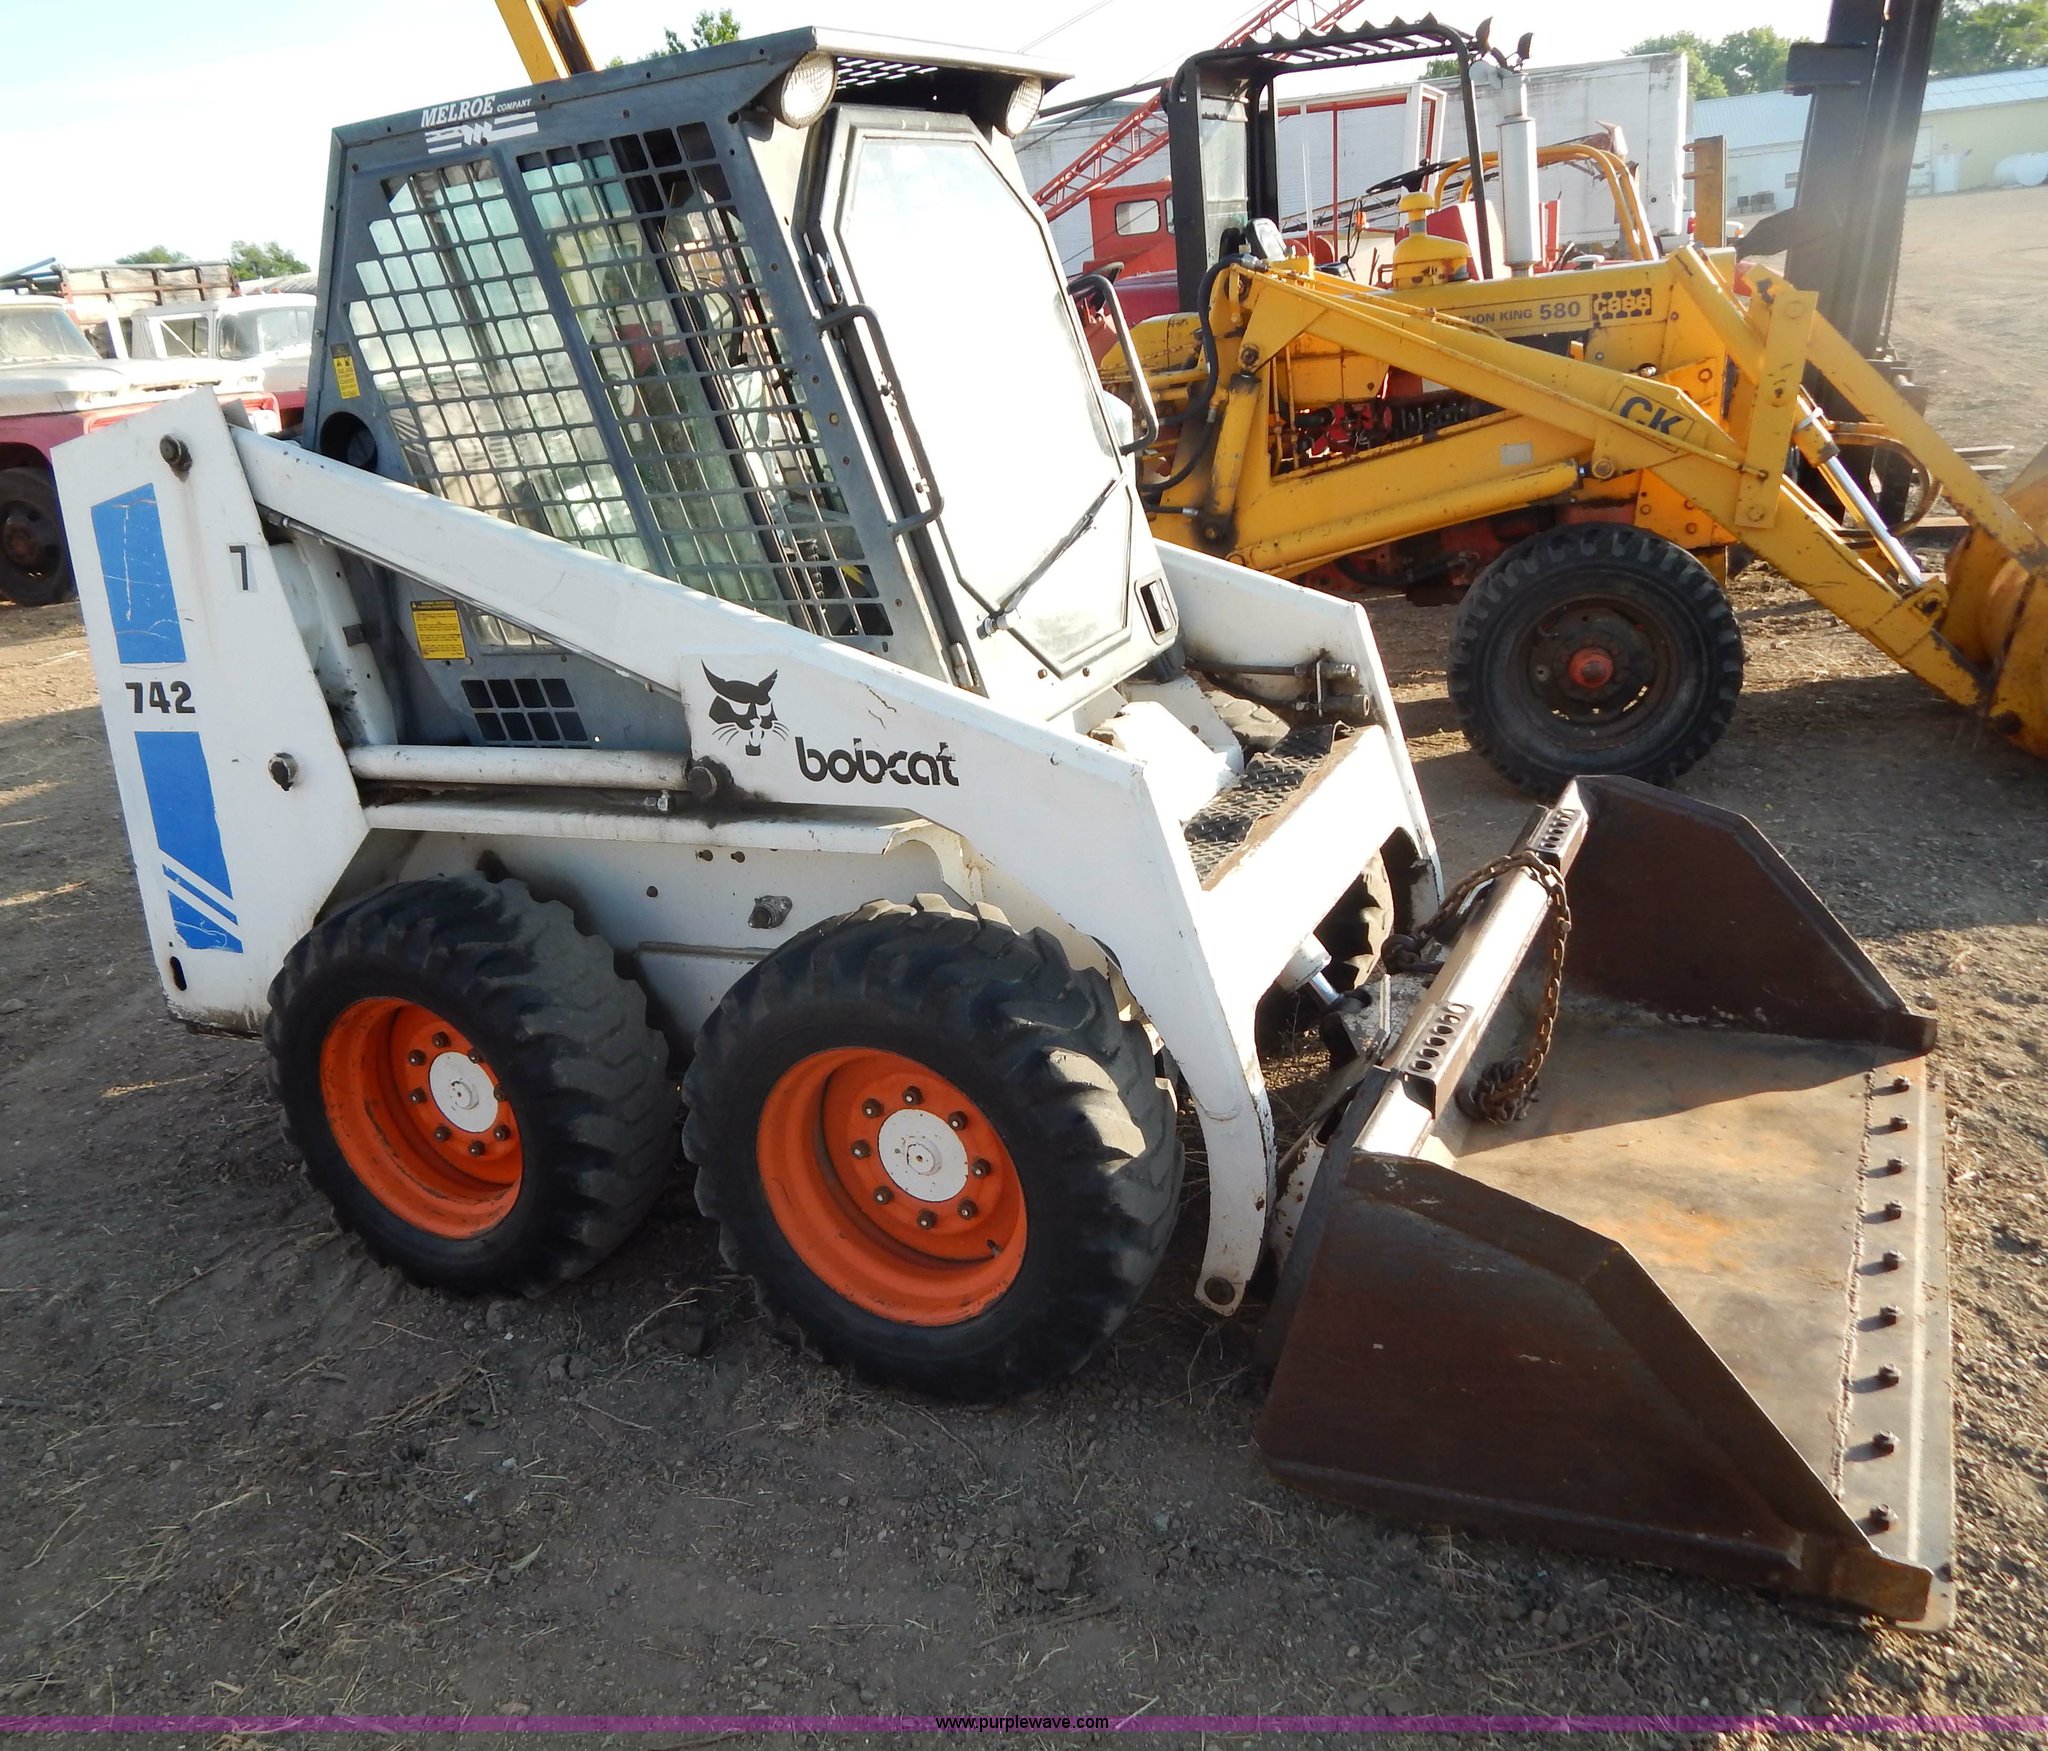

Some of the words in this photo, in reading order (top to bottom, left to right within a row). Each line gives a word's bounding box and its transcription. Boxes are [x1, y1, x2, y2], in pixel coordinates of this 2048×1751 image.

[421, 95, 496, 128] MELROE
[497, 98, 532, 113] COMPANY
[1500, 307, 1533, 321] KING
[1539, 300, 1581, 321] 580
[1619, 395, 1685, 435] CK
[228, 545, 249, 591] 7
[124, 680, 196, 714] 742
[794, 736, 960, 787] bobcat
